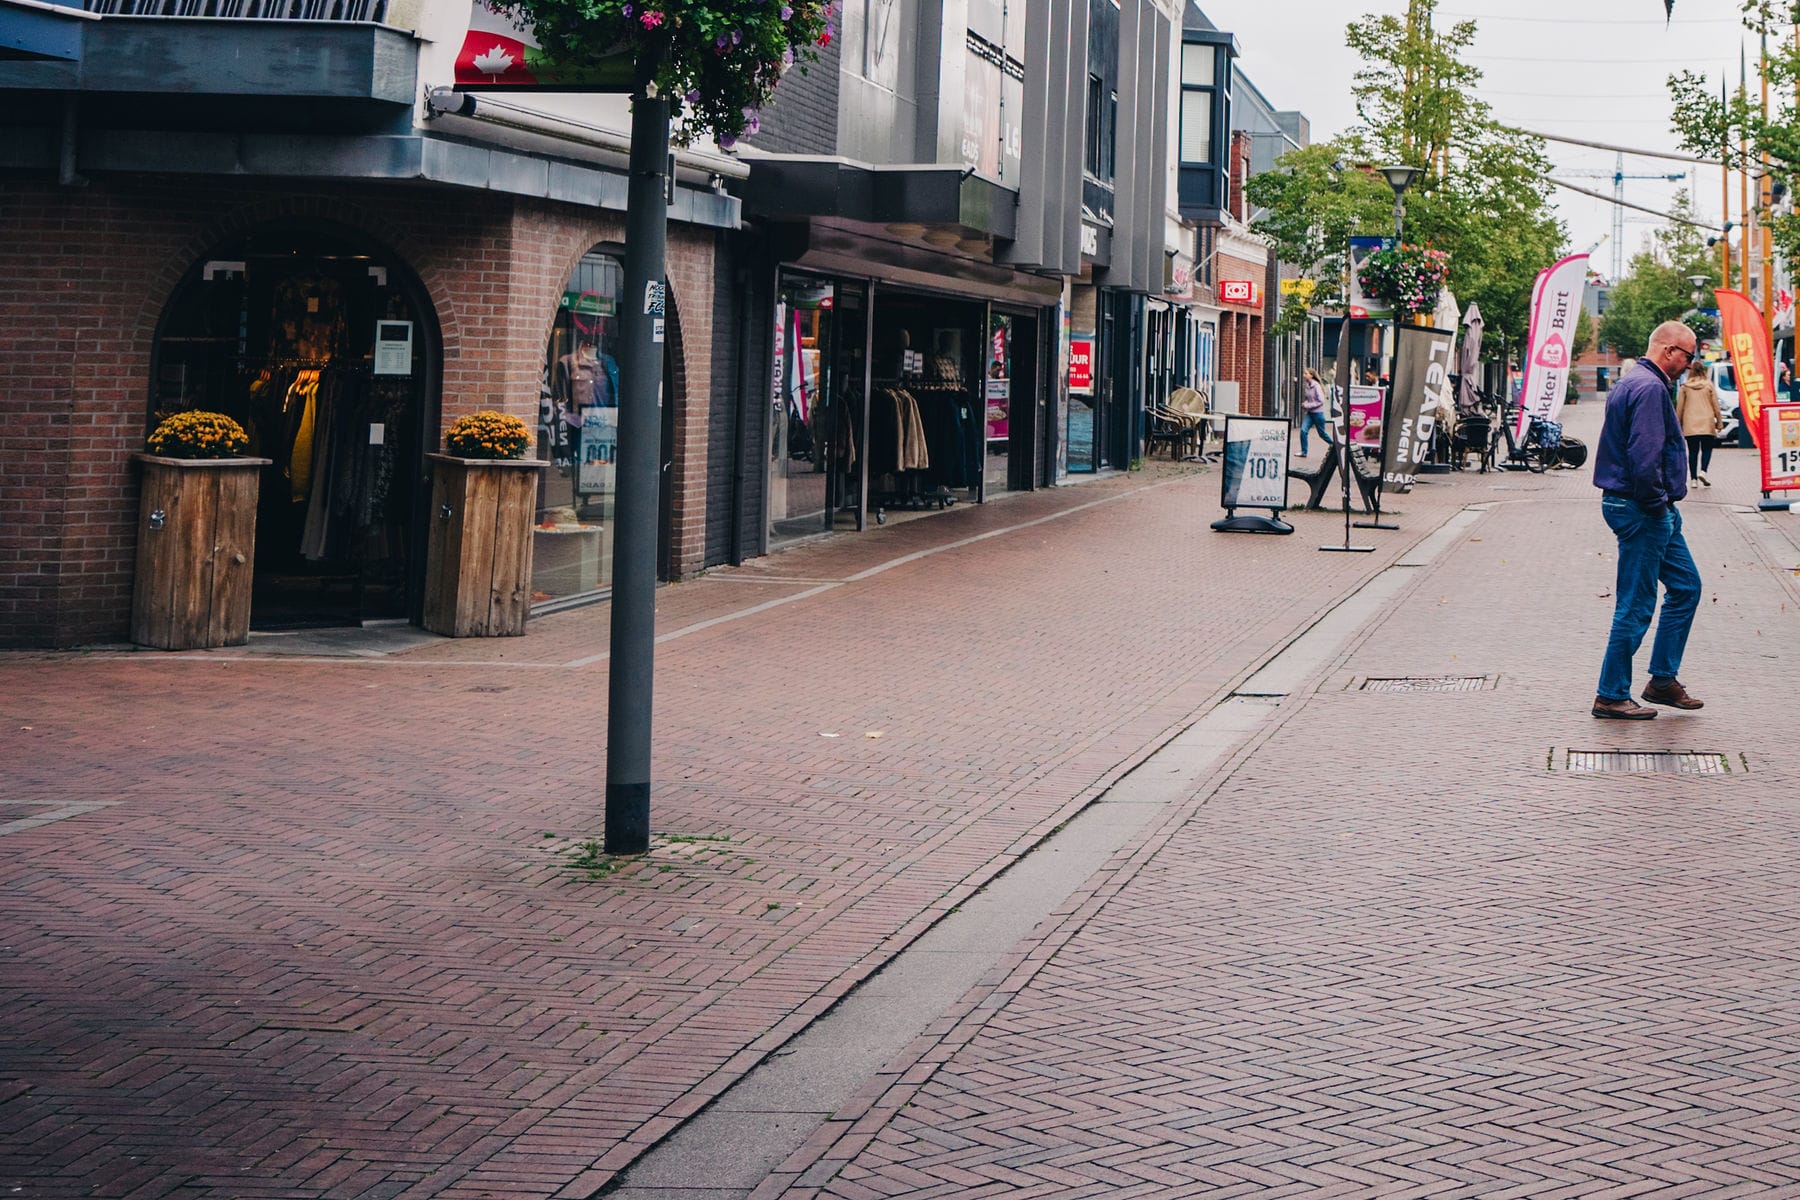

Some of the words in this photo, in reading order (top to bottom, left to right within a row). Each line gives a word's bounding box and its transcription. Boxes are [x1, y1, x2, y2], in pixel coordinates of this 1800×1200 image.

[1536, 371, 1557, 421] akker
[1551, 290, 1570, 330] Bart
[1411, 340, 1449, 464] LEADS
[1260, 434, 1285, 442] JONES
[1396, 417, 1414, 464] MEN
[1250, 495, 1282, 503] LEADS
